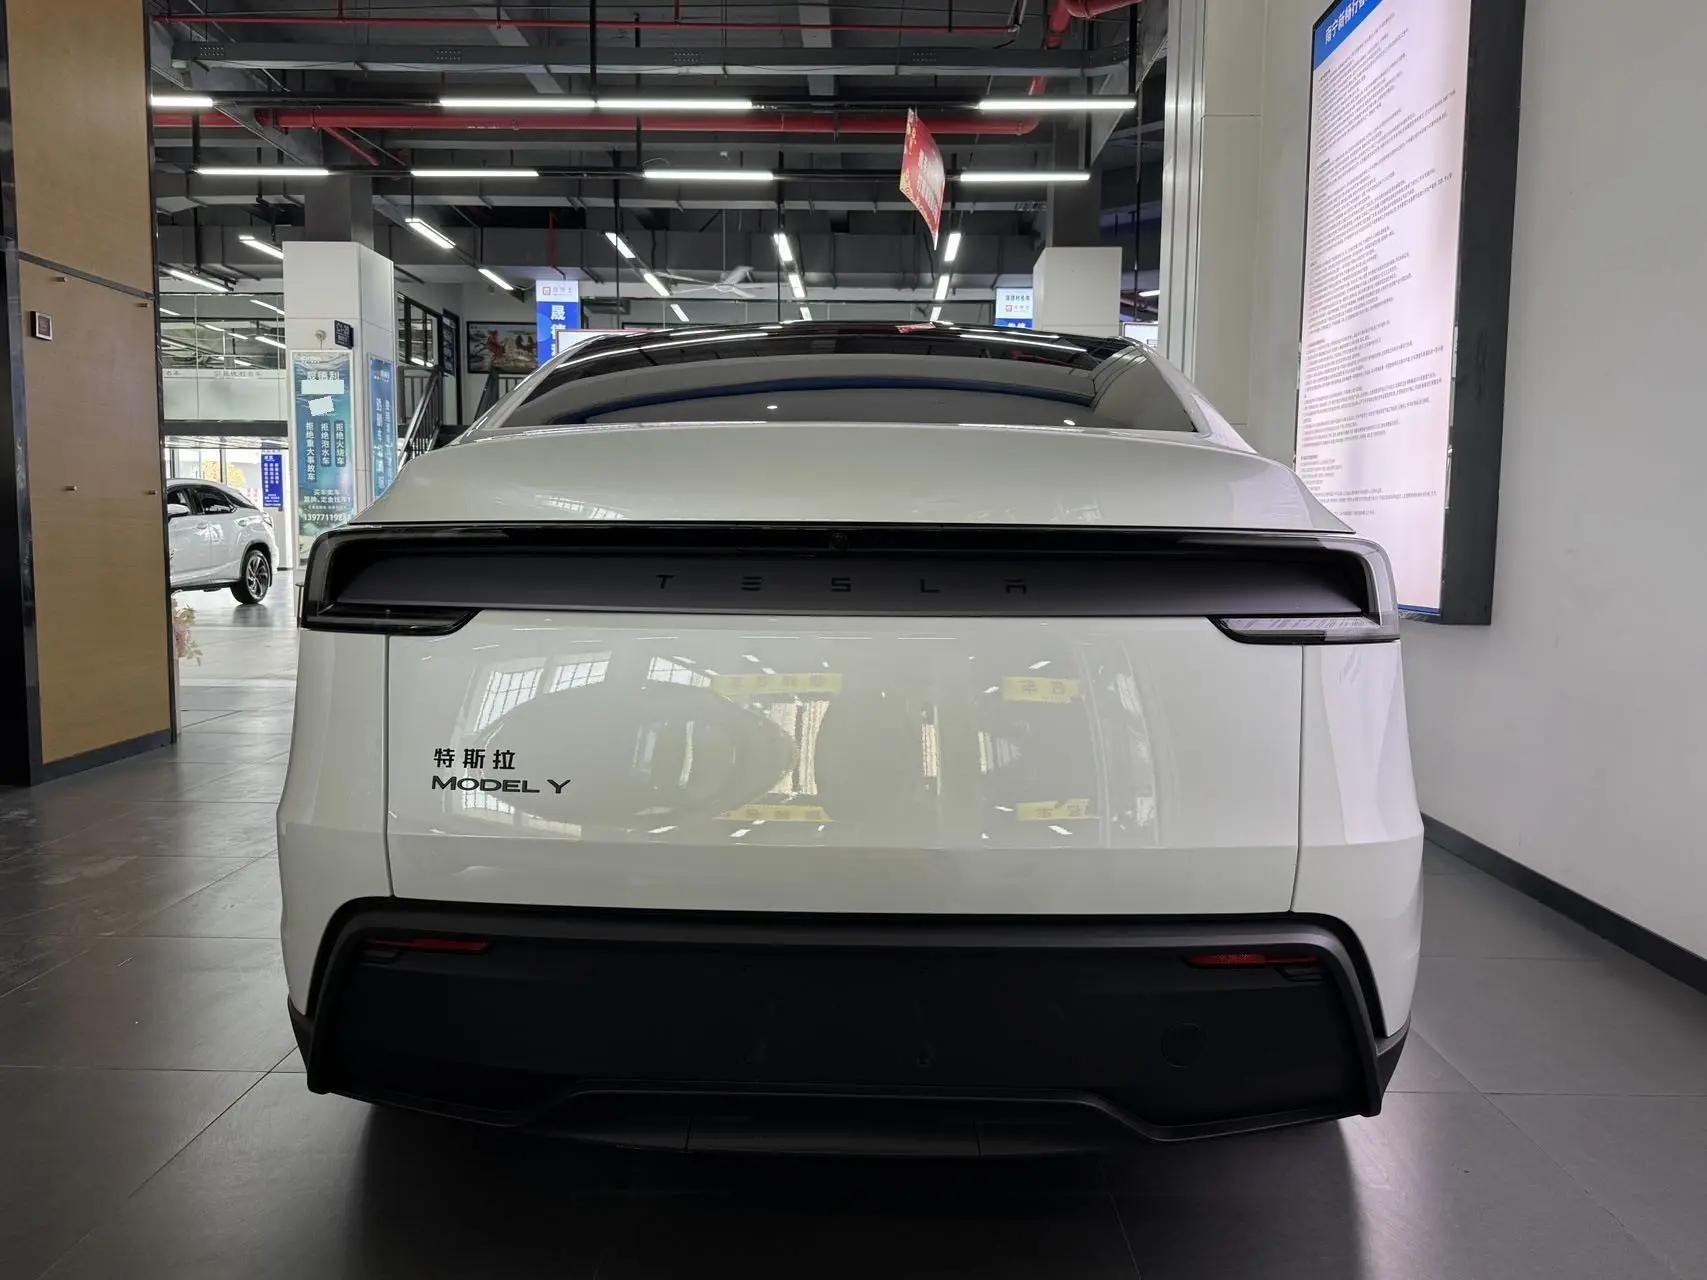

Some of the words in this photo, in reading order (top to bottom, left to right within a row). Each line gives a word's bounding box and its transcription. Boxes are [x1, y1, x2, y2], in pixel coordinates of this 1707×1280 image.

[305, 422, 316, 481] 拒绝重大事故车
[656, 574, 1027, 595] TESLA
[434, 748, 516, 770] 特斯拉
[431, 775, 540, 793] MODEL
[547, 779, 571, 794] Y
